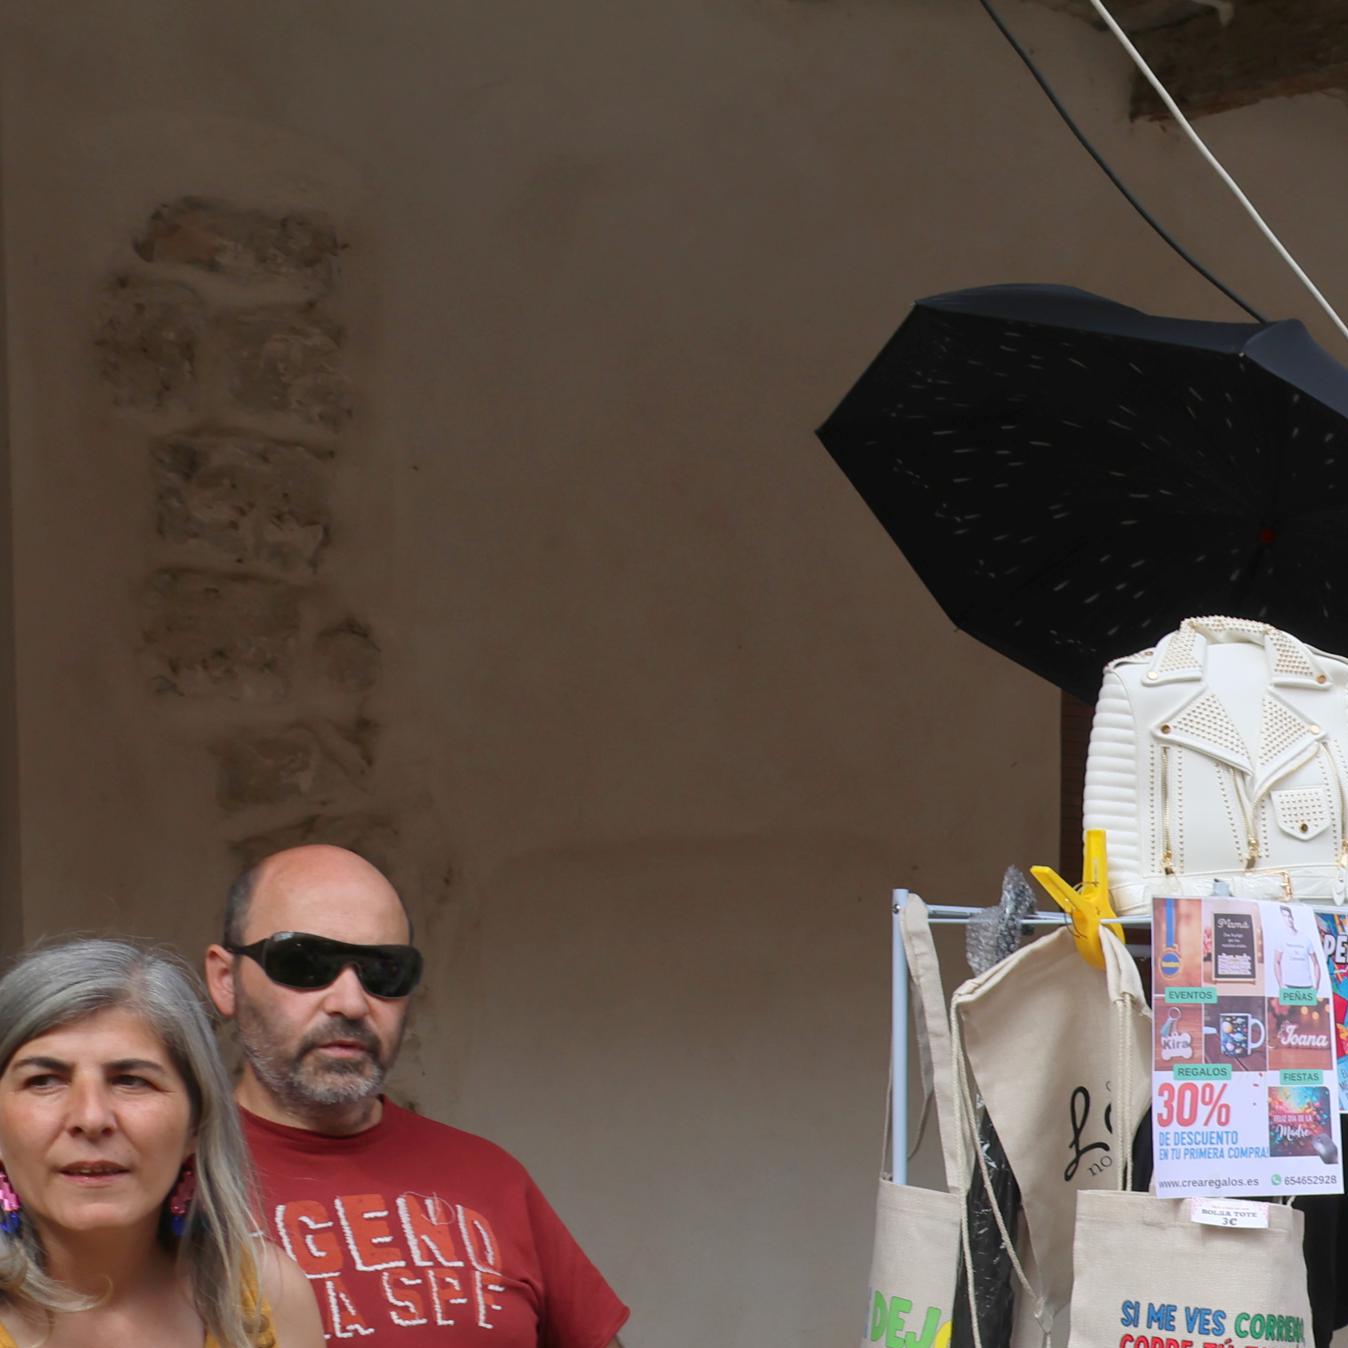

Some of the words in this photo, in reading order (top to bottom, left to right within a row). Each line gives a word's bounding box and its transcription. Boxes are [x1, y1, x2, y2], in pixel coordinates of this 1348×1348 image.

[1168, 990, 1213, 1001] EVENTOS
[1283, 988, 1313, 1001] PEÑAS
[1281, 1024, 1329, 1047] Joana
[1163, 1038, 1190, 1050] Kira
[1177, 1067, 1227, 1077] REGALOS
[1283, 1073, 1319, 1082] FIESTAS
[1157, 1082, 1231, 1127] 30%
[1159, 1132, 1171, 1146] DE
[1173, 1131, 1238, 1145] DESCUENTO
[1159, 1148, 1169, 1160] EN
[1171, 1148, 1181, 1160] TU
[1184, 1147, 1225, 1159] PRIMERA
[1159, 1177, 1259, 1188] www.crearegalos.es
[1284, 1175, 1337, 1185] 654652928
[1120, 1300, 1141, 1328] SI
[1146, 1303, 1178, 1331] ME
[1184, 1306, 1227, 1336] VES
